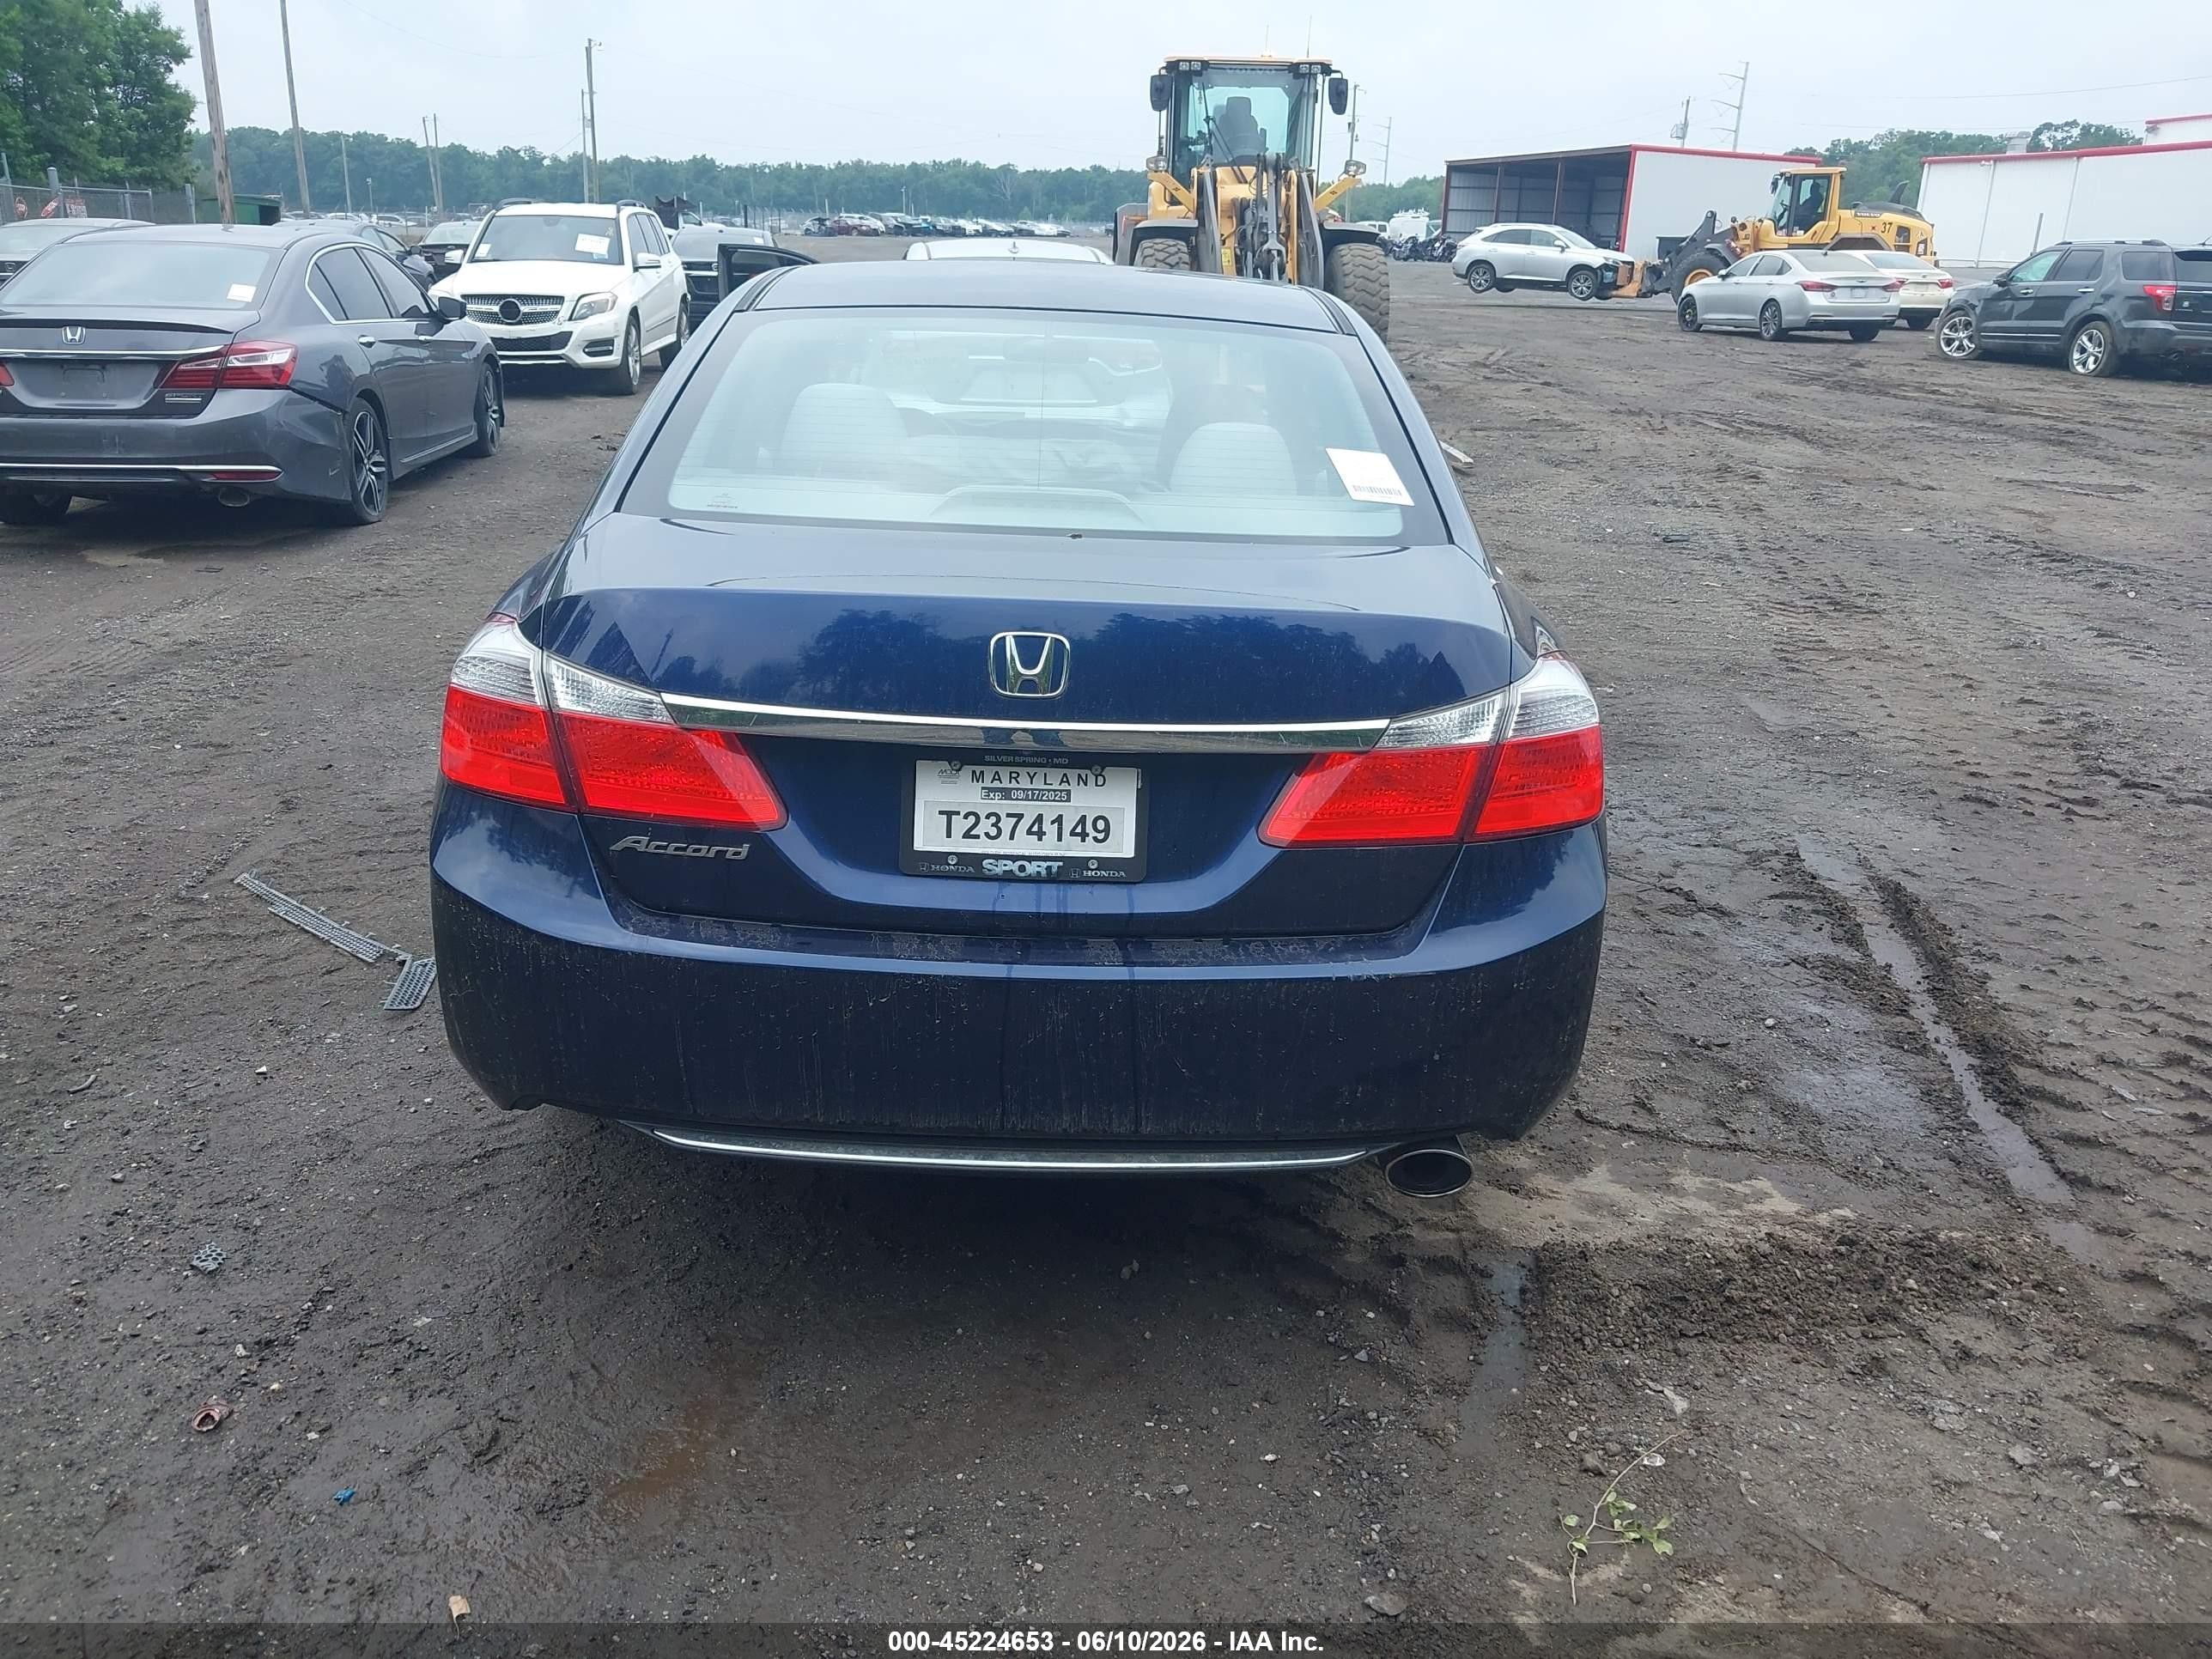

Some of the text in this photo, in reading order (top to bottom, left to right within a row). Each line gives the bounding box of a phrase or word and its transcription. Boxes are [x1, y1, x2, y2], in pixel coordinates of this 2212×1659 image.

[1881, 222, 1893, 234] 37
[970, 769, 1107, 787] MARYLAND
[981, 790, 1067, 801] Exp: 09/17/2025
[938, 810, 1111, 844] T2374149
[610, 836, 750, 860] Accord
[931, 864, 975, 873] HONDA
[981, 859, 1063, 878] SPORT
